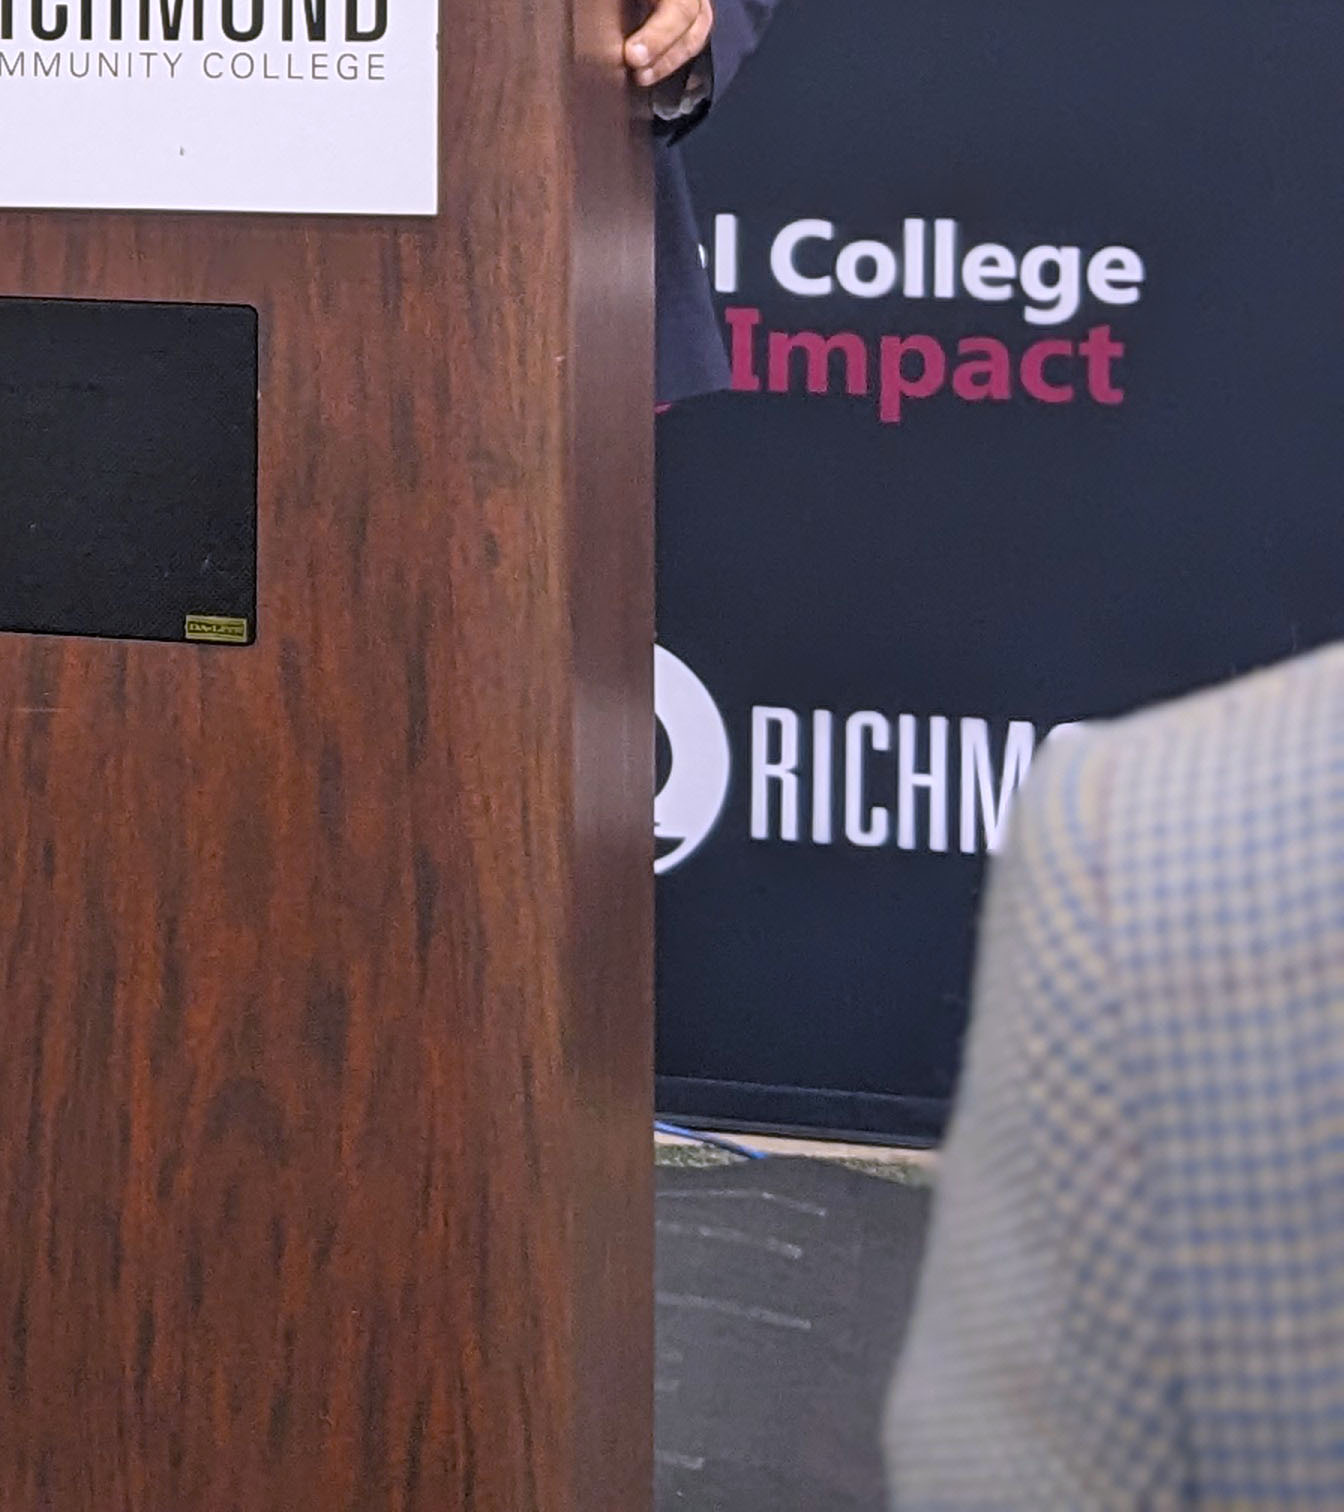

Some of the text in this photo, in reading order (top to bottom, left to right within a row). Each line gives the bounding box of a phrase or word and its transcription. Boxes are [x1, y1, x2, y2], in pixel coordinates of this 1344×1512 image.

[202, 51, 386, 81] COLLEGE
[771, 219, 1143, 324] College
[727, 309, 1122, 421] Impact
[750, 705, 1081, 854] RICHM
